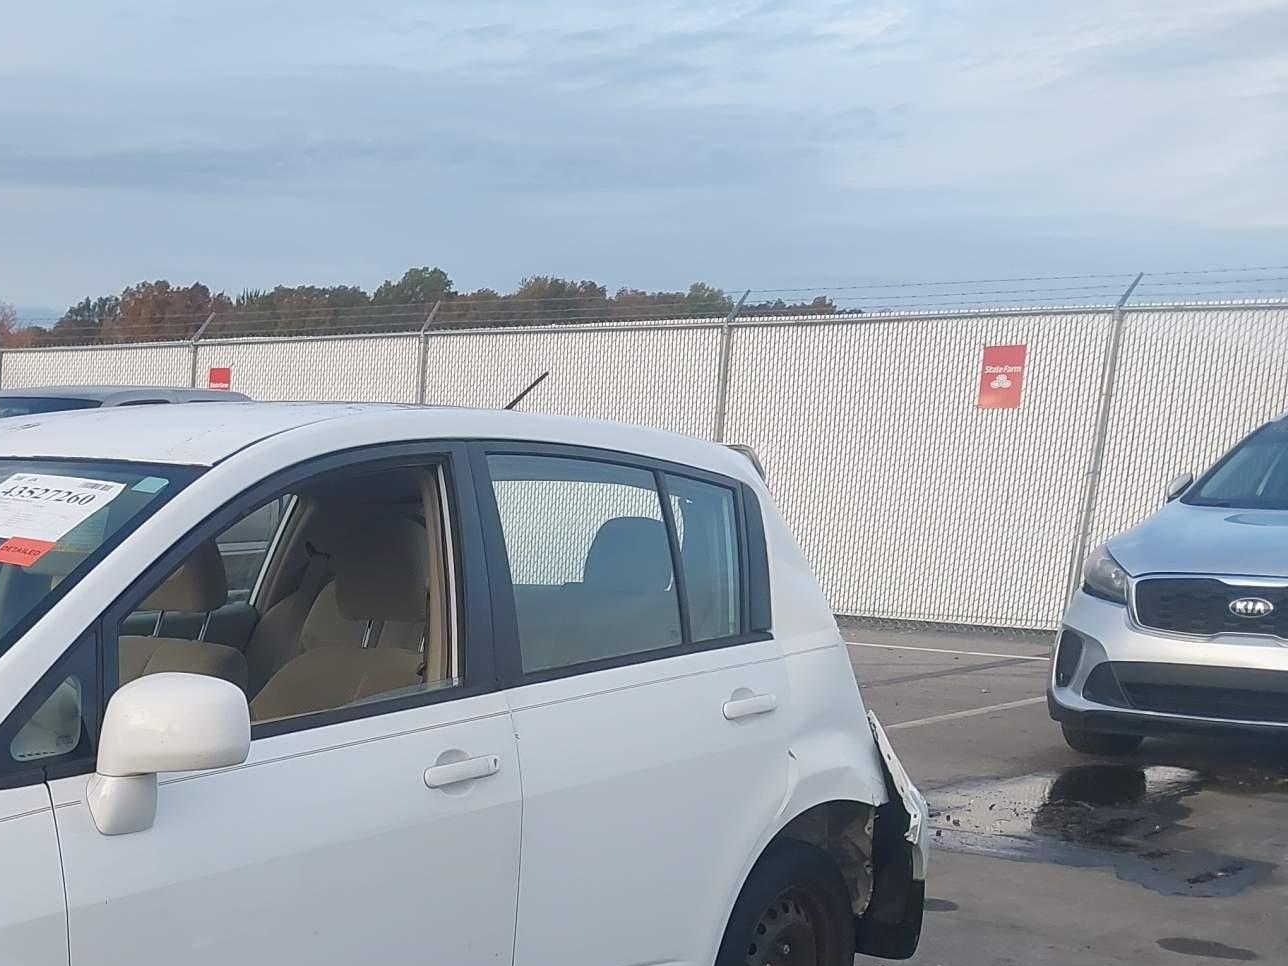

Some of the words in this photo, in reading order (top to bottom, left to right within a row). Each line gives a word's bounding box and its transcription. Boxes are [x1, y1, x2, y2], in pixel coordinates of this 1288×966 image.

[984, 365, 1003, 373] State
[1003, 365, 1022, 373] Farm
[1, 485, 96, 505] 43527260
[1, 545, 41, 556] DETAILED
[1235, 600, 1265, 614] KIA
